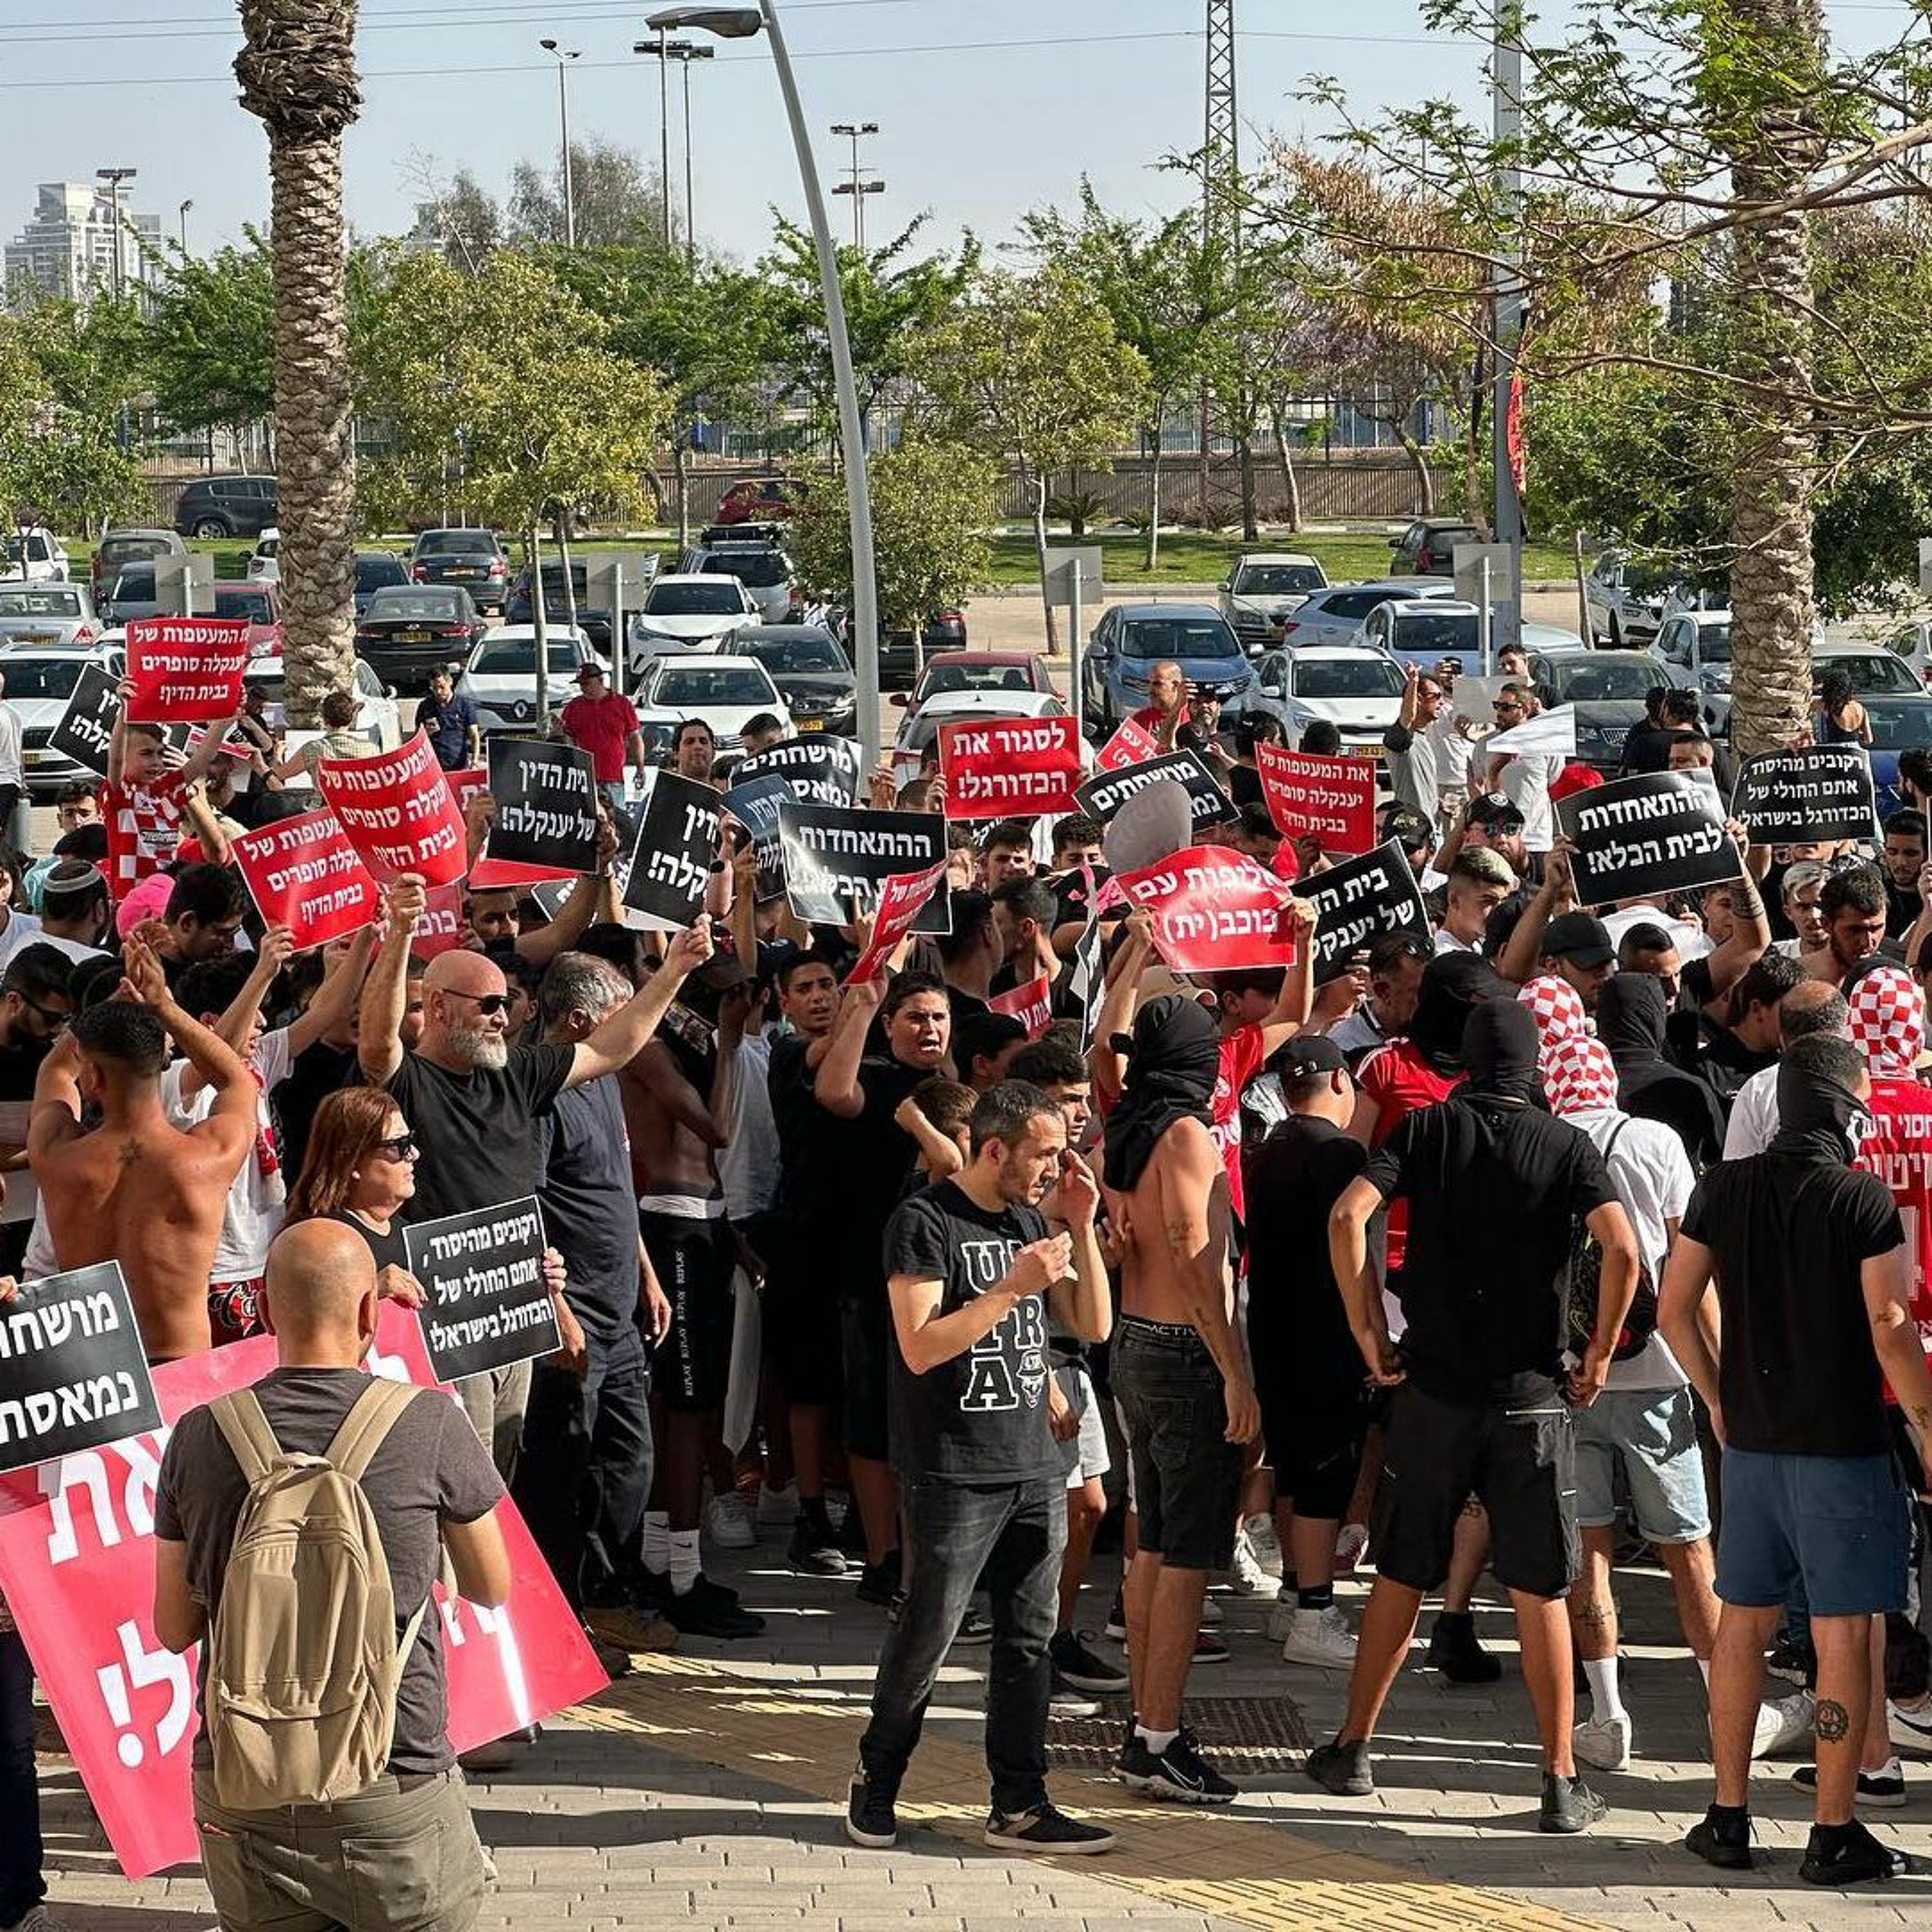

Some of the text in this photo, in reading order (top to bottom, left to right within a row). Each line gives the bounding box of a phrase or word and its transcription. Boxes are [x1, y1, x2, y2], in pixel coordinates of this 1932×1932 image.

[135, 625, 157, 643] של
[163, 627, 239, 644] המעטפות
[142, 654, 199, 672] סופרים
[160, 684, 229, 706] בבית הדין!
[69, 714, 111, 754] קלה!
[953, 721, 1066, 756] לסגור את
[741, 744, 853, 774] מושחתים
[1277, 756, 1343, 779] המעטפות
[1347, 767, 1370, 782] את
[1808, 754, 1864, 773] רקובים
[519, 759, 562, 792] הדין
[958, 769, 1067, 799] הכדורגל!
[1747, 779, 1859, 800] אתם החולי של
[786, 779, 851, 809] נמאס
[1309, 786, 1364, 810] יענקלה
[1578, 789, 1707, 831] ההתאחדות
[502, 800, 596, 842] של יענקלה!
[1309, 816, 1347, 833] בבית
[1806, 805, 1871, 825] הכדורגל
[242, 816, 344, 862] עטפות של
[799, 826, 932, 858] ההתאחדות
[1587, 822, 1722, 874] לבית הכלא!
[267, 858, 327, 892] סופרים
[647, 851, 710, 903] קלה!
[1130, 871, 1179, 900] עם
[1309, 867, 1389, 915] בית הד
[301, 883, 365, 925] בבית הדין!
[1312, 899, 1414, 962] של יענק
[492, 1213, 539, 1246] רקובים
[434, 1256, 539, 1305] אתם החולי של
[499, 1297, 553, 1334] הכדורגל
